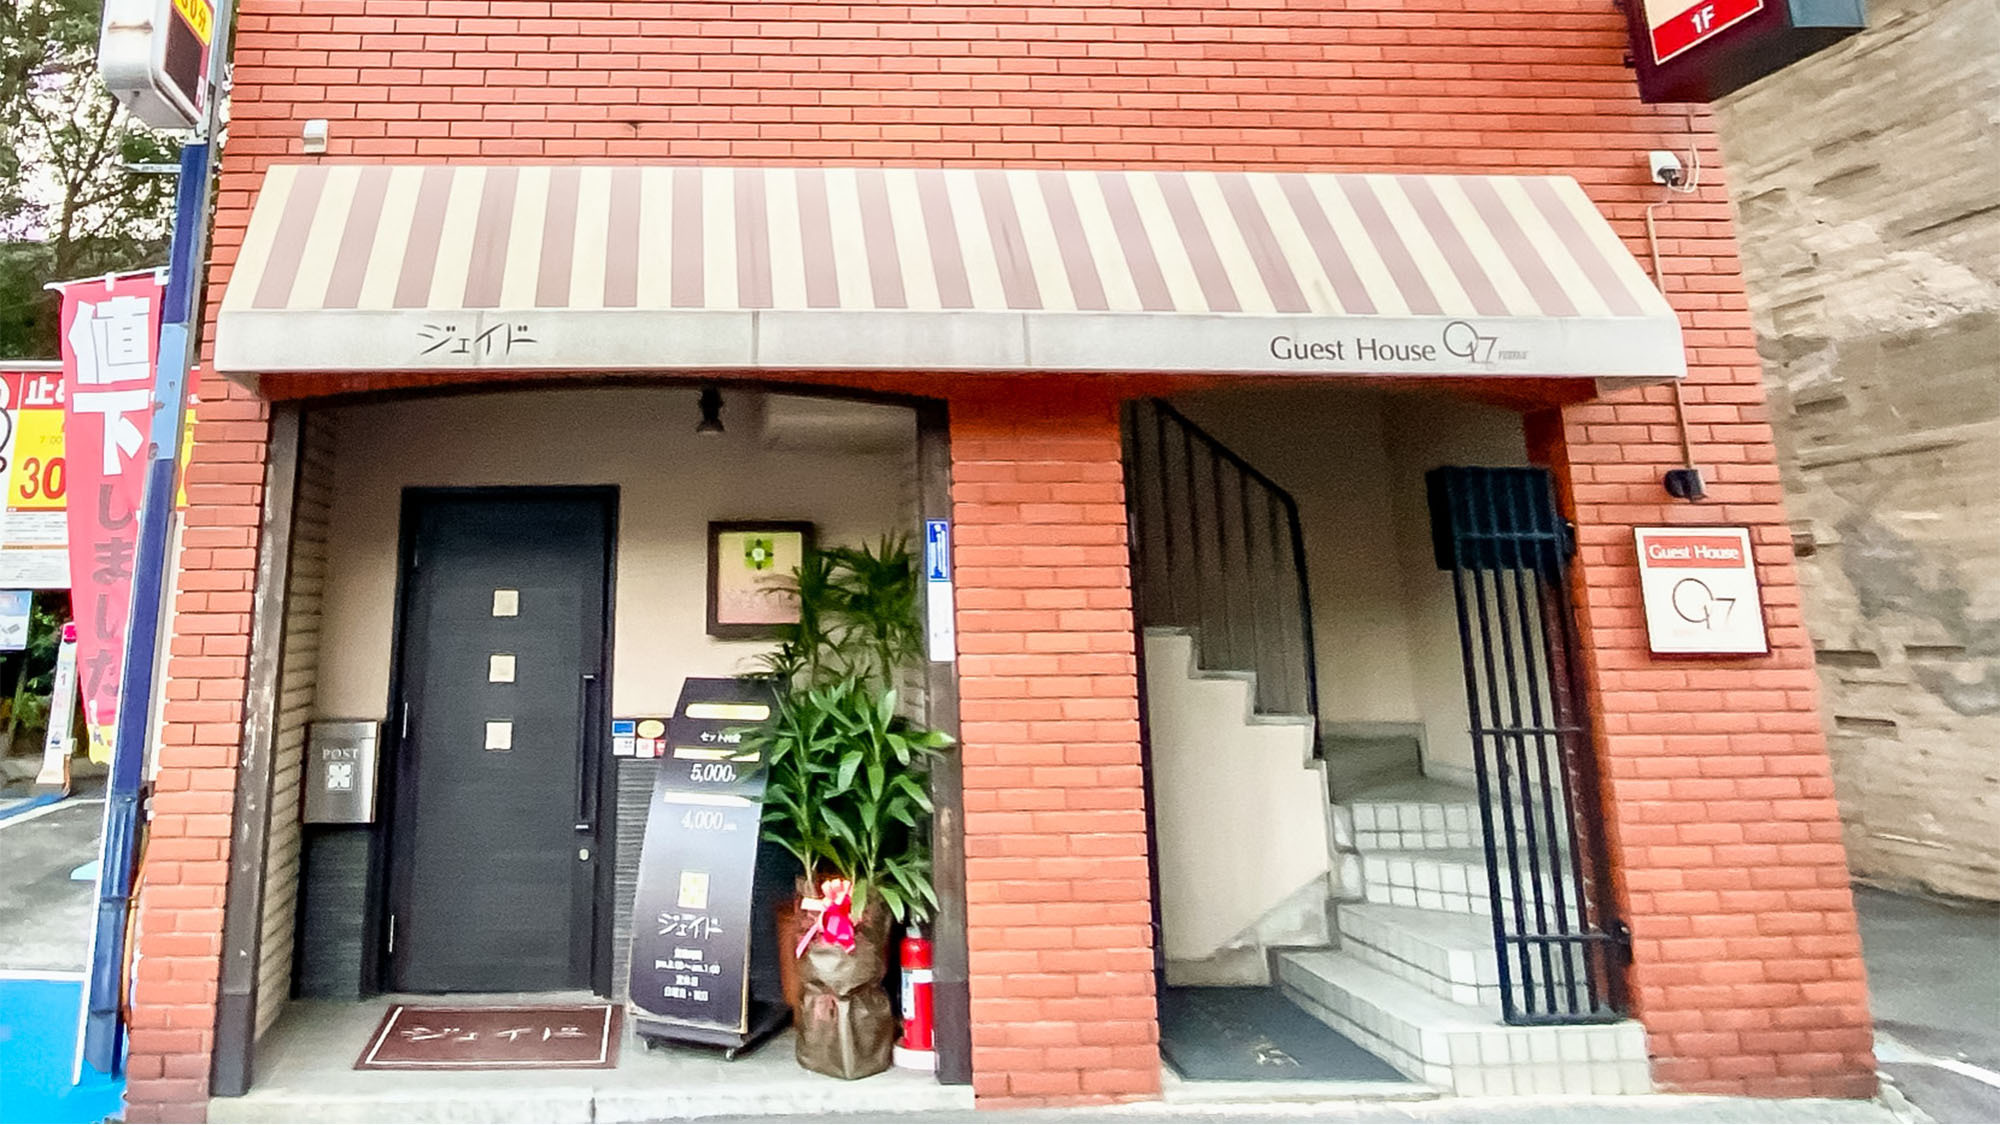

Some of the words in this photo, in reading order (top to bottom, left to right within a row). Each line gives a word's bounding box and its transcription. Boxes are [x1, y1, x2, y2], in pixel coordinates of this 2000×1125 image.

[1690, 4, 1715, 33] 1F
[416, 322, 538, 356] ジェイド
[1270, 335, 1345, 361] Guest
[1356, 337, 1437, 361] House
[25, 376, 64, 405] 止
[1648, 543, 1691, 560] Guest
[1693, 543, 1739, 561] House
[322, 748, 359, 760] POST
[657, 912, 724, 940] ジェイド
[400, 1026, 588, 1042] ジェイド
